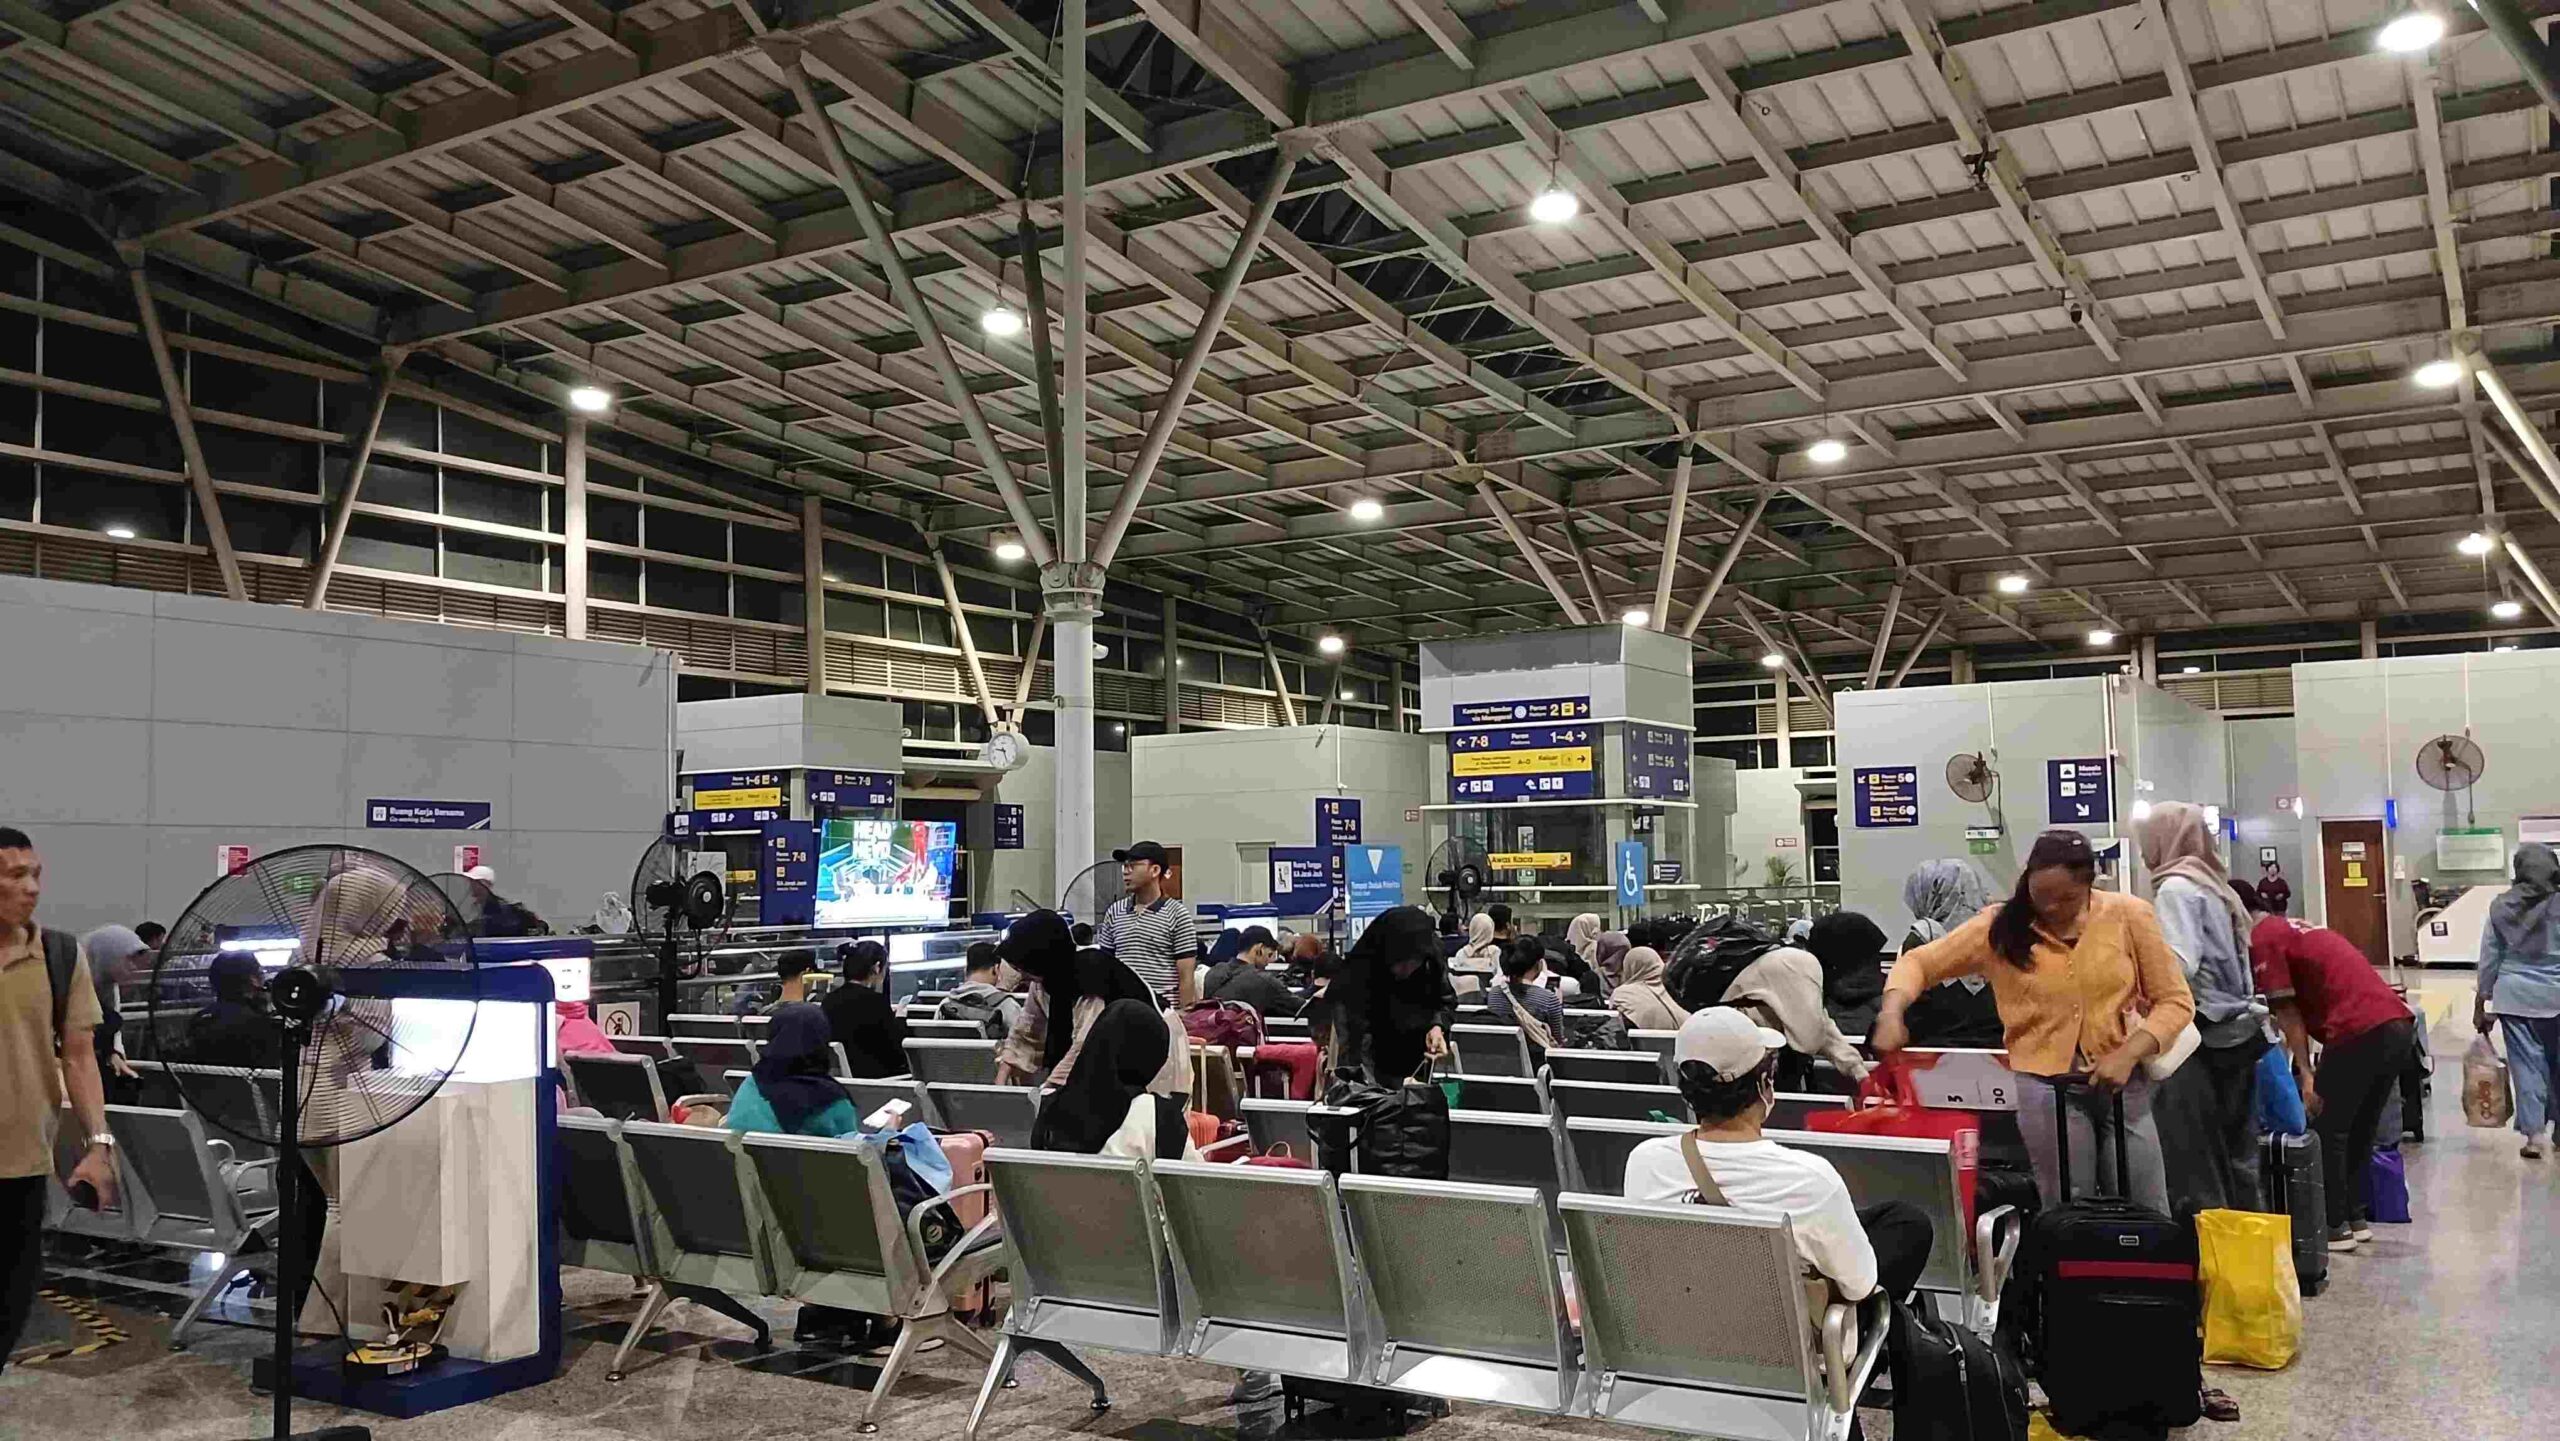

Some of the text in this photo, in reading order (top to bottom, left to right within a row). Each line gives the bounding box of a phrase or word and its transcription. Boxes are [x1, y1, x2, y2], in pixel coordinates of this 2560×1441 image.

[1550, 704, 1559, 716] 2
[1898, 773, 1904, 782] 5
[1899, 806, 1906, 815] 6
